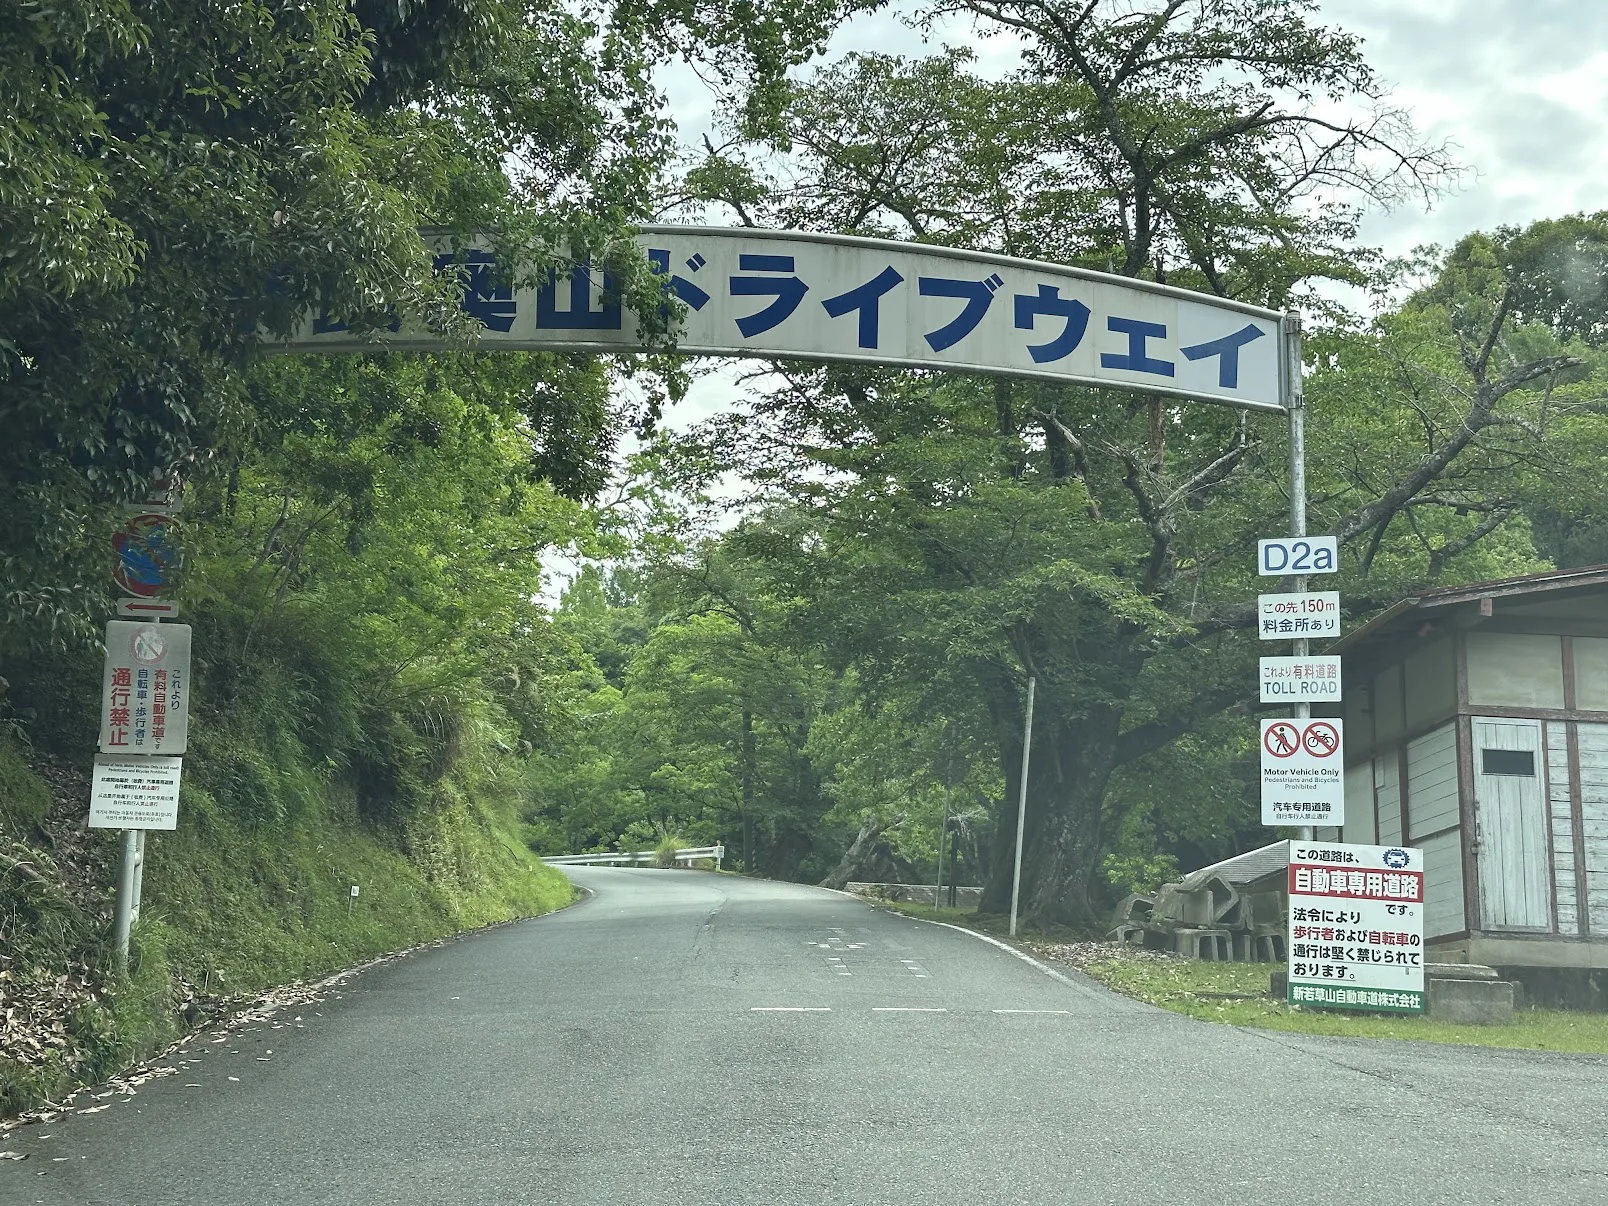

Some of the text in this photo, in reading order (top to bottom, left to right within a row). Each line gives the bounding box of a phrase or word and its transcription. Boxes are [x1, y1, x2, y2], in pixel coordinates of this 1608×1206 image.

[1264, 542, 1332, 571] D2a
[1263, 618, 1334, 633] 料金所あり
[170, 670, 182, 710] これより
[1264, 681, 1337, 694] TOLL ROAD
[108, 667, 131, 746] 通行禁止
[1273, 802, 1331, 812] 汽车专用道路
[1295, 868, 1419, 899] 自動車専用道路
[1293, 907, 1360, 924] 法令により
[1386, 904, 1414, 916] です。
[1293, 926, 1420, 946] 歩行者および自転車の
[1293, 943, 1420, 965] 通行は堅く禁じられて
[1294, 963, 1355, 979] おります。
[1293, 986, 1420, 1008] 新若草山自動車道株式会社
